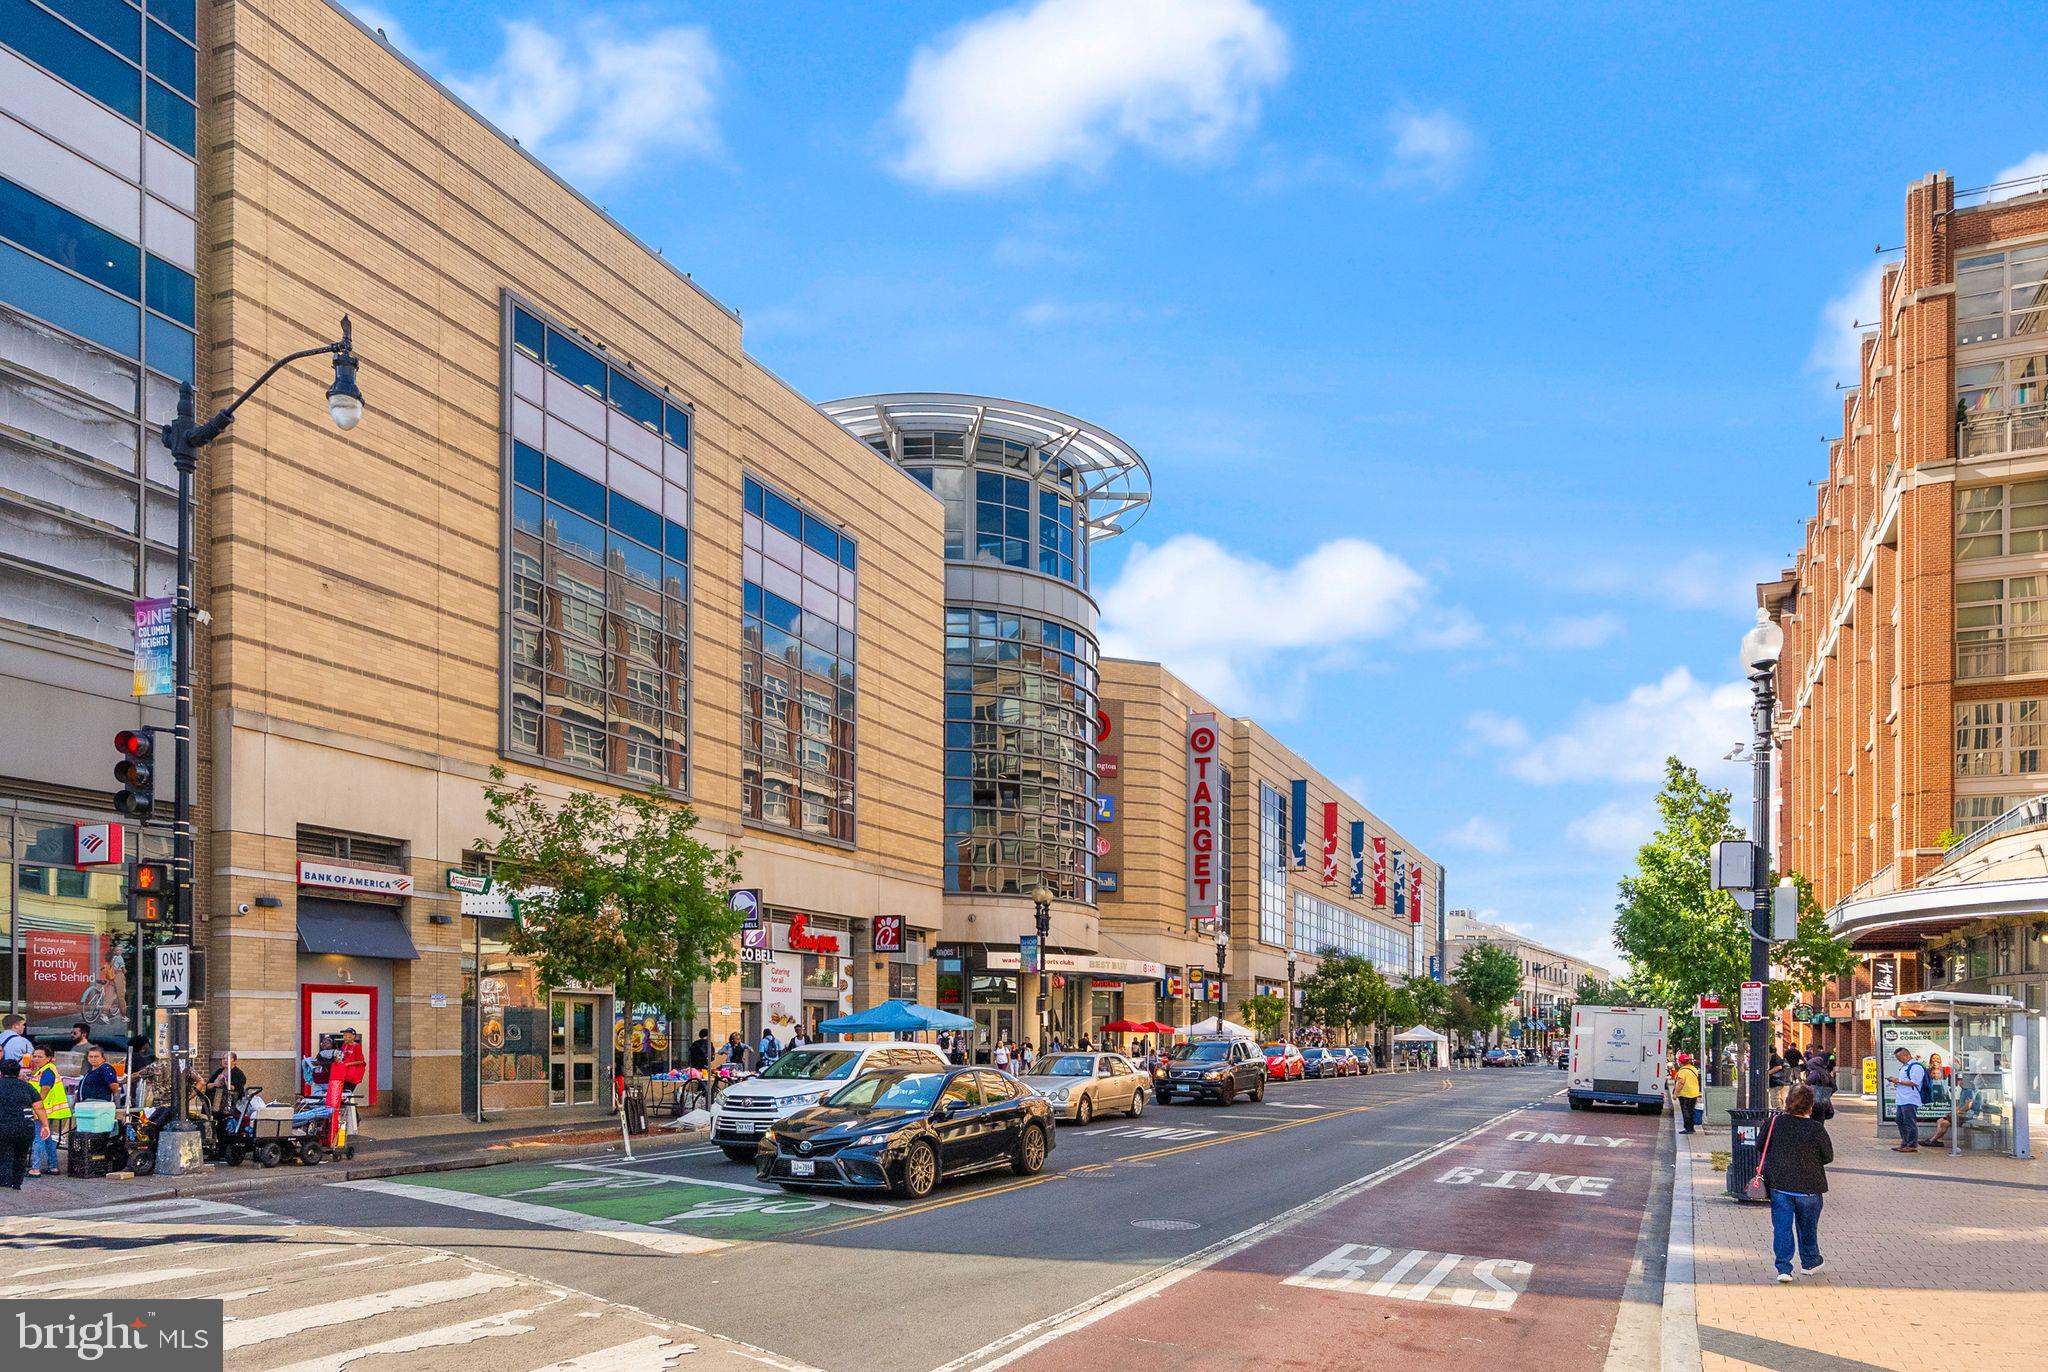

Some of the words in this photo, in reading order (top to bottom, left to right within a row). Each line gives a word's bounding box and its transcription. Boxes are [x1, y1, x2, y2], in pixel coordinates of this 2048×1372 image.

[136, 608, 171, 627] DINE
[138, 624, 170, 637] COLUMBIA
[140, 636, 168, 648] HEIGHTS
[1097, 763, 1116, 772] ngton
[1193, 757, 1212, 900] TARGET
[304, 871, 332, 882] BANK
[334, 875, 347, 884] OF
[348, 877, 391, 889] AMERICA
[1098, 878, 1116, 887] halls
[146, 898, 157, 919] 6
[33, 943, 66, 956] Leave
[740, 947, 754, 960] CO
[755, 949, 776, 962] BELL
[33, 958, 78, 972] monthly
[162, 951, 184, 967] ONE
[1089, 960, 1111, 969] BEST
[1112, 962, 1128, 971] BUY
[34, 969, 58, 981] fees
[60, 971, 96, 983] behind
[161, 968, 184, 984] WAY
[771, 967, 791, 978] Catering
[1505, 1131, 1634, 1148] ONLY
[1433, 1166, 1614, 1197] BIKE
[1280, 1243, 1535, 1312] BUS
